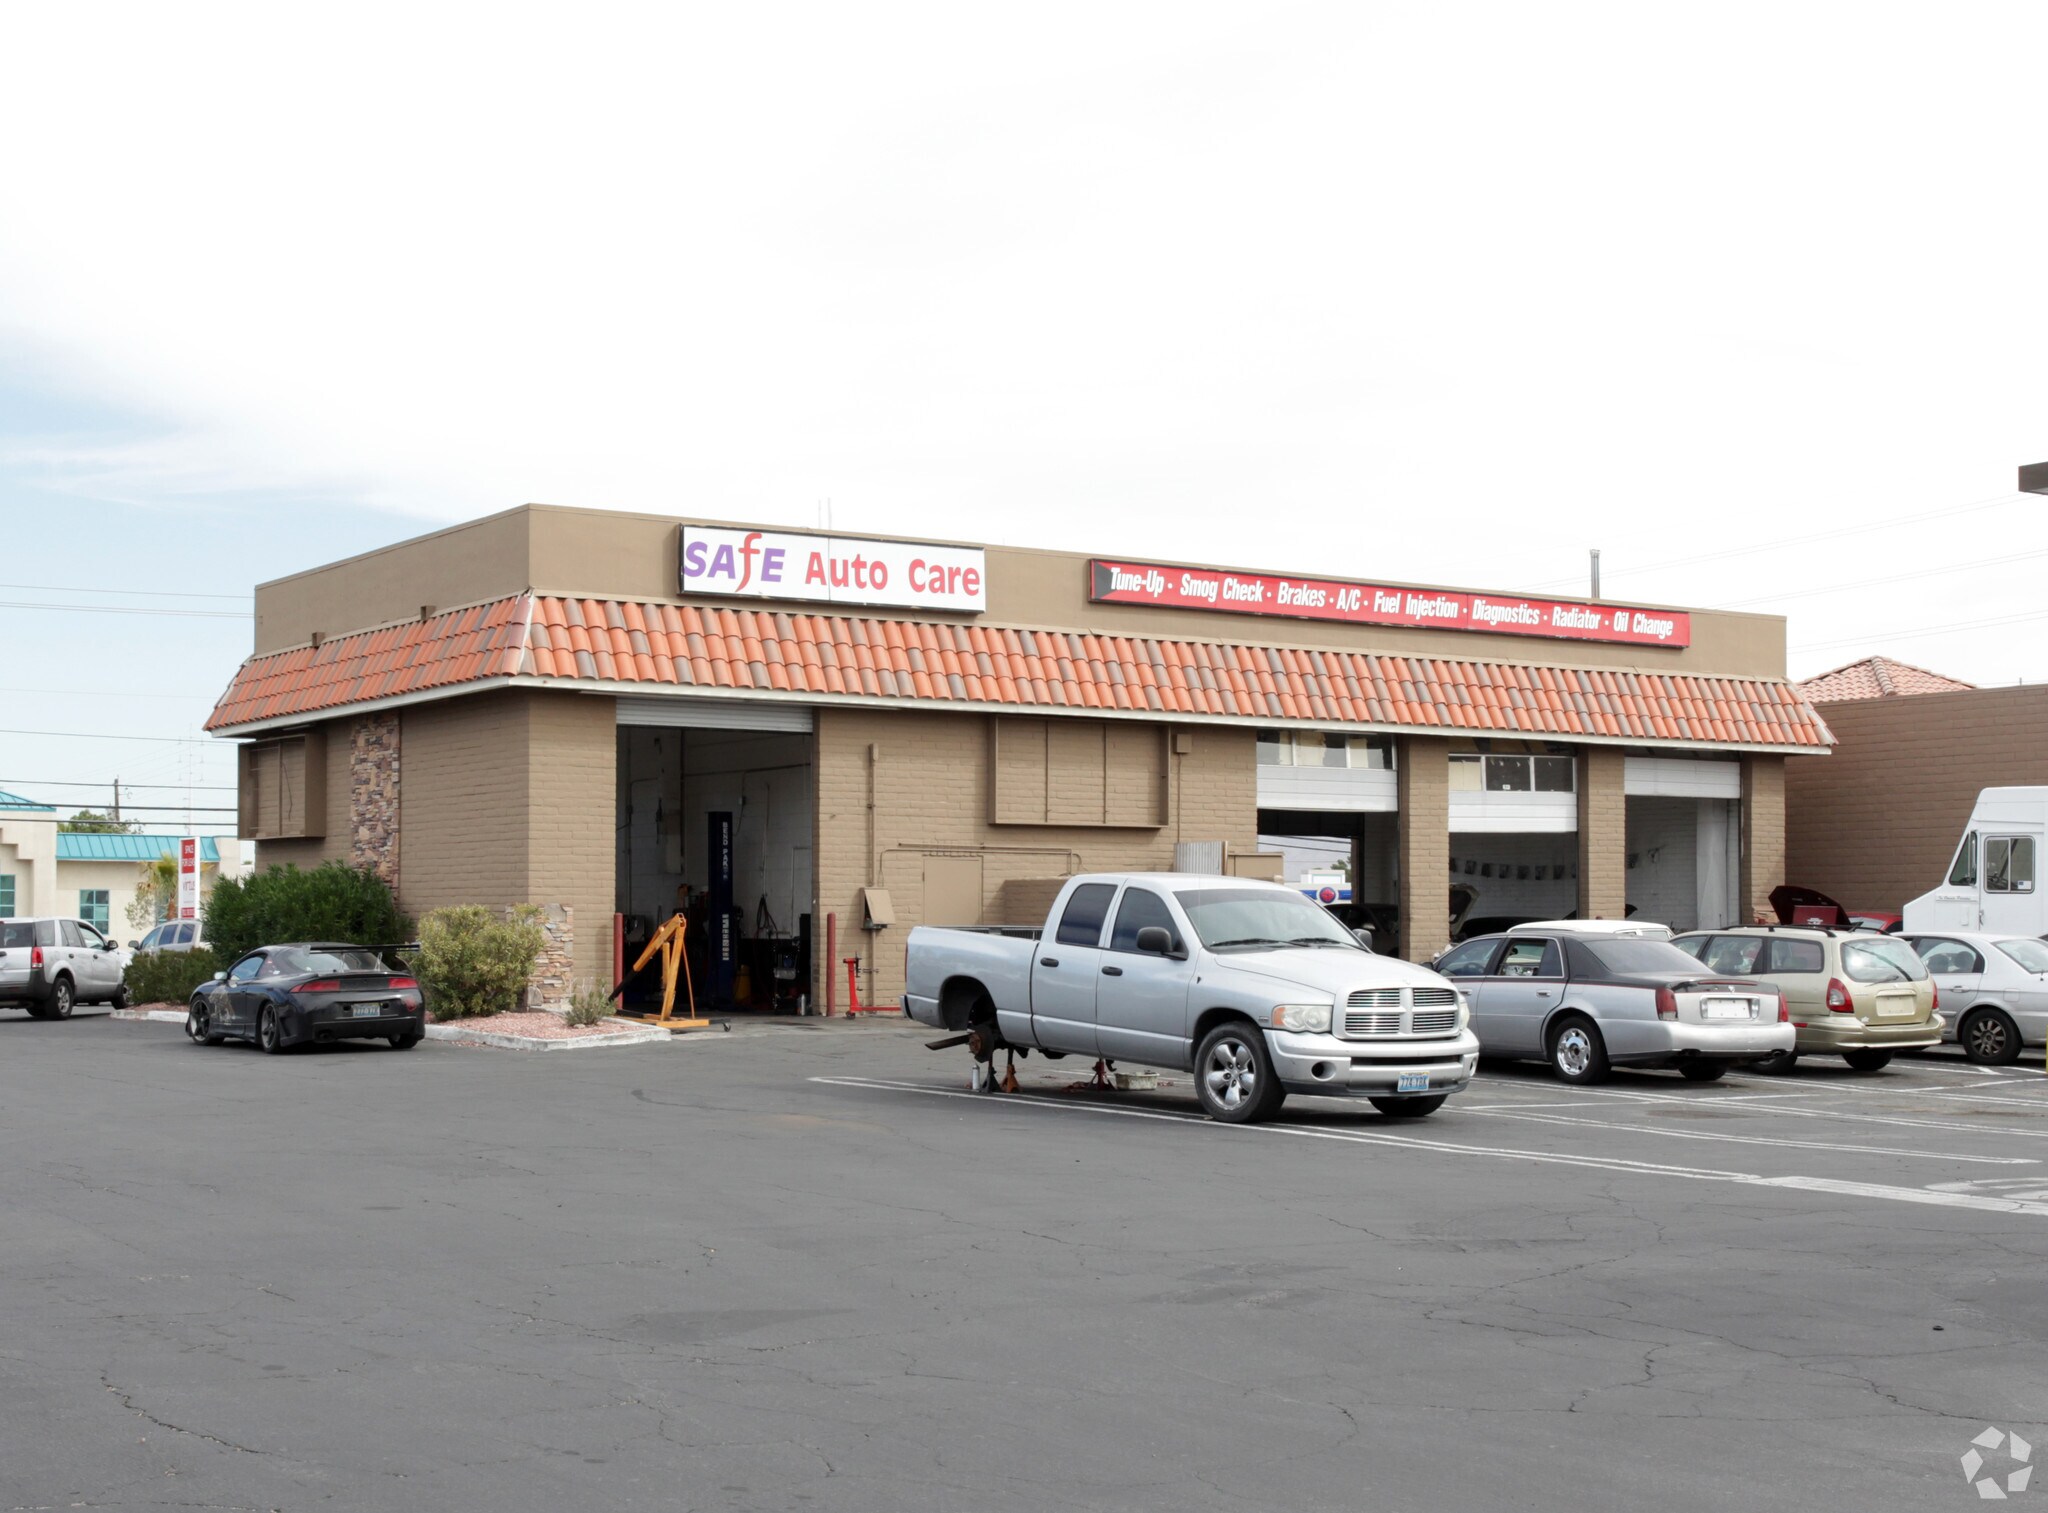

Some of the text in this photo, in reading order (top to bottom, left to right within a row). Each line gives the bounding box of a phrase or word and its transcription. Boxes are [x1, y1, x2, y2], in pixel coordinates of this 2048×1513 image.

[805, 552, 888, 590] Auto
[908, 558, 980, 596] Care
[1110, 567, 1674, 640] Tune-Up Smog Check Brakes A/C Fuel Injection Diagnostics Radiator Oil Change
